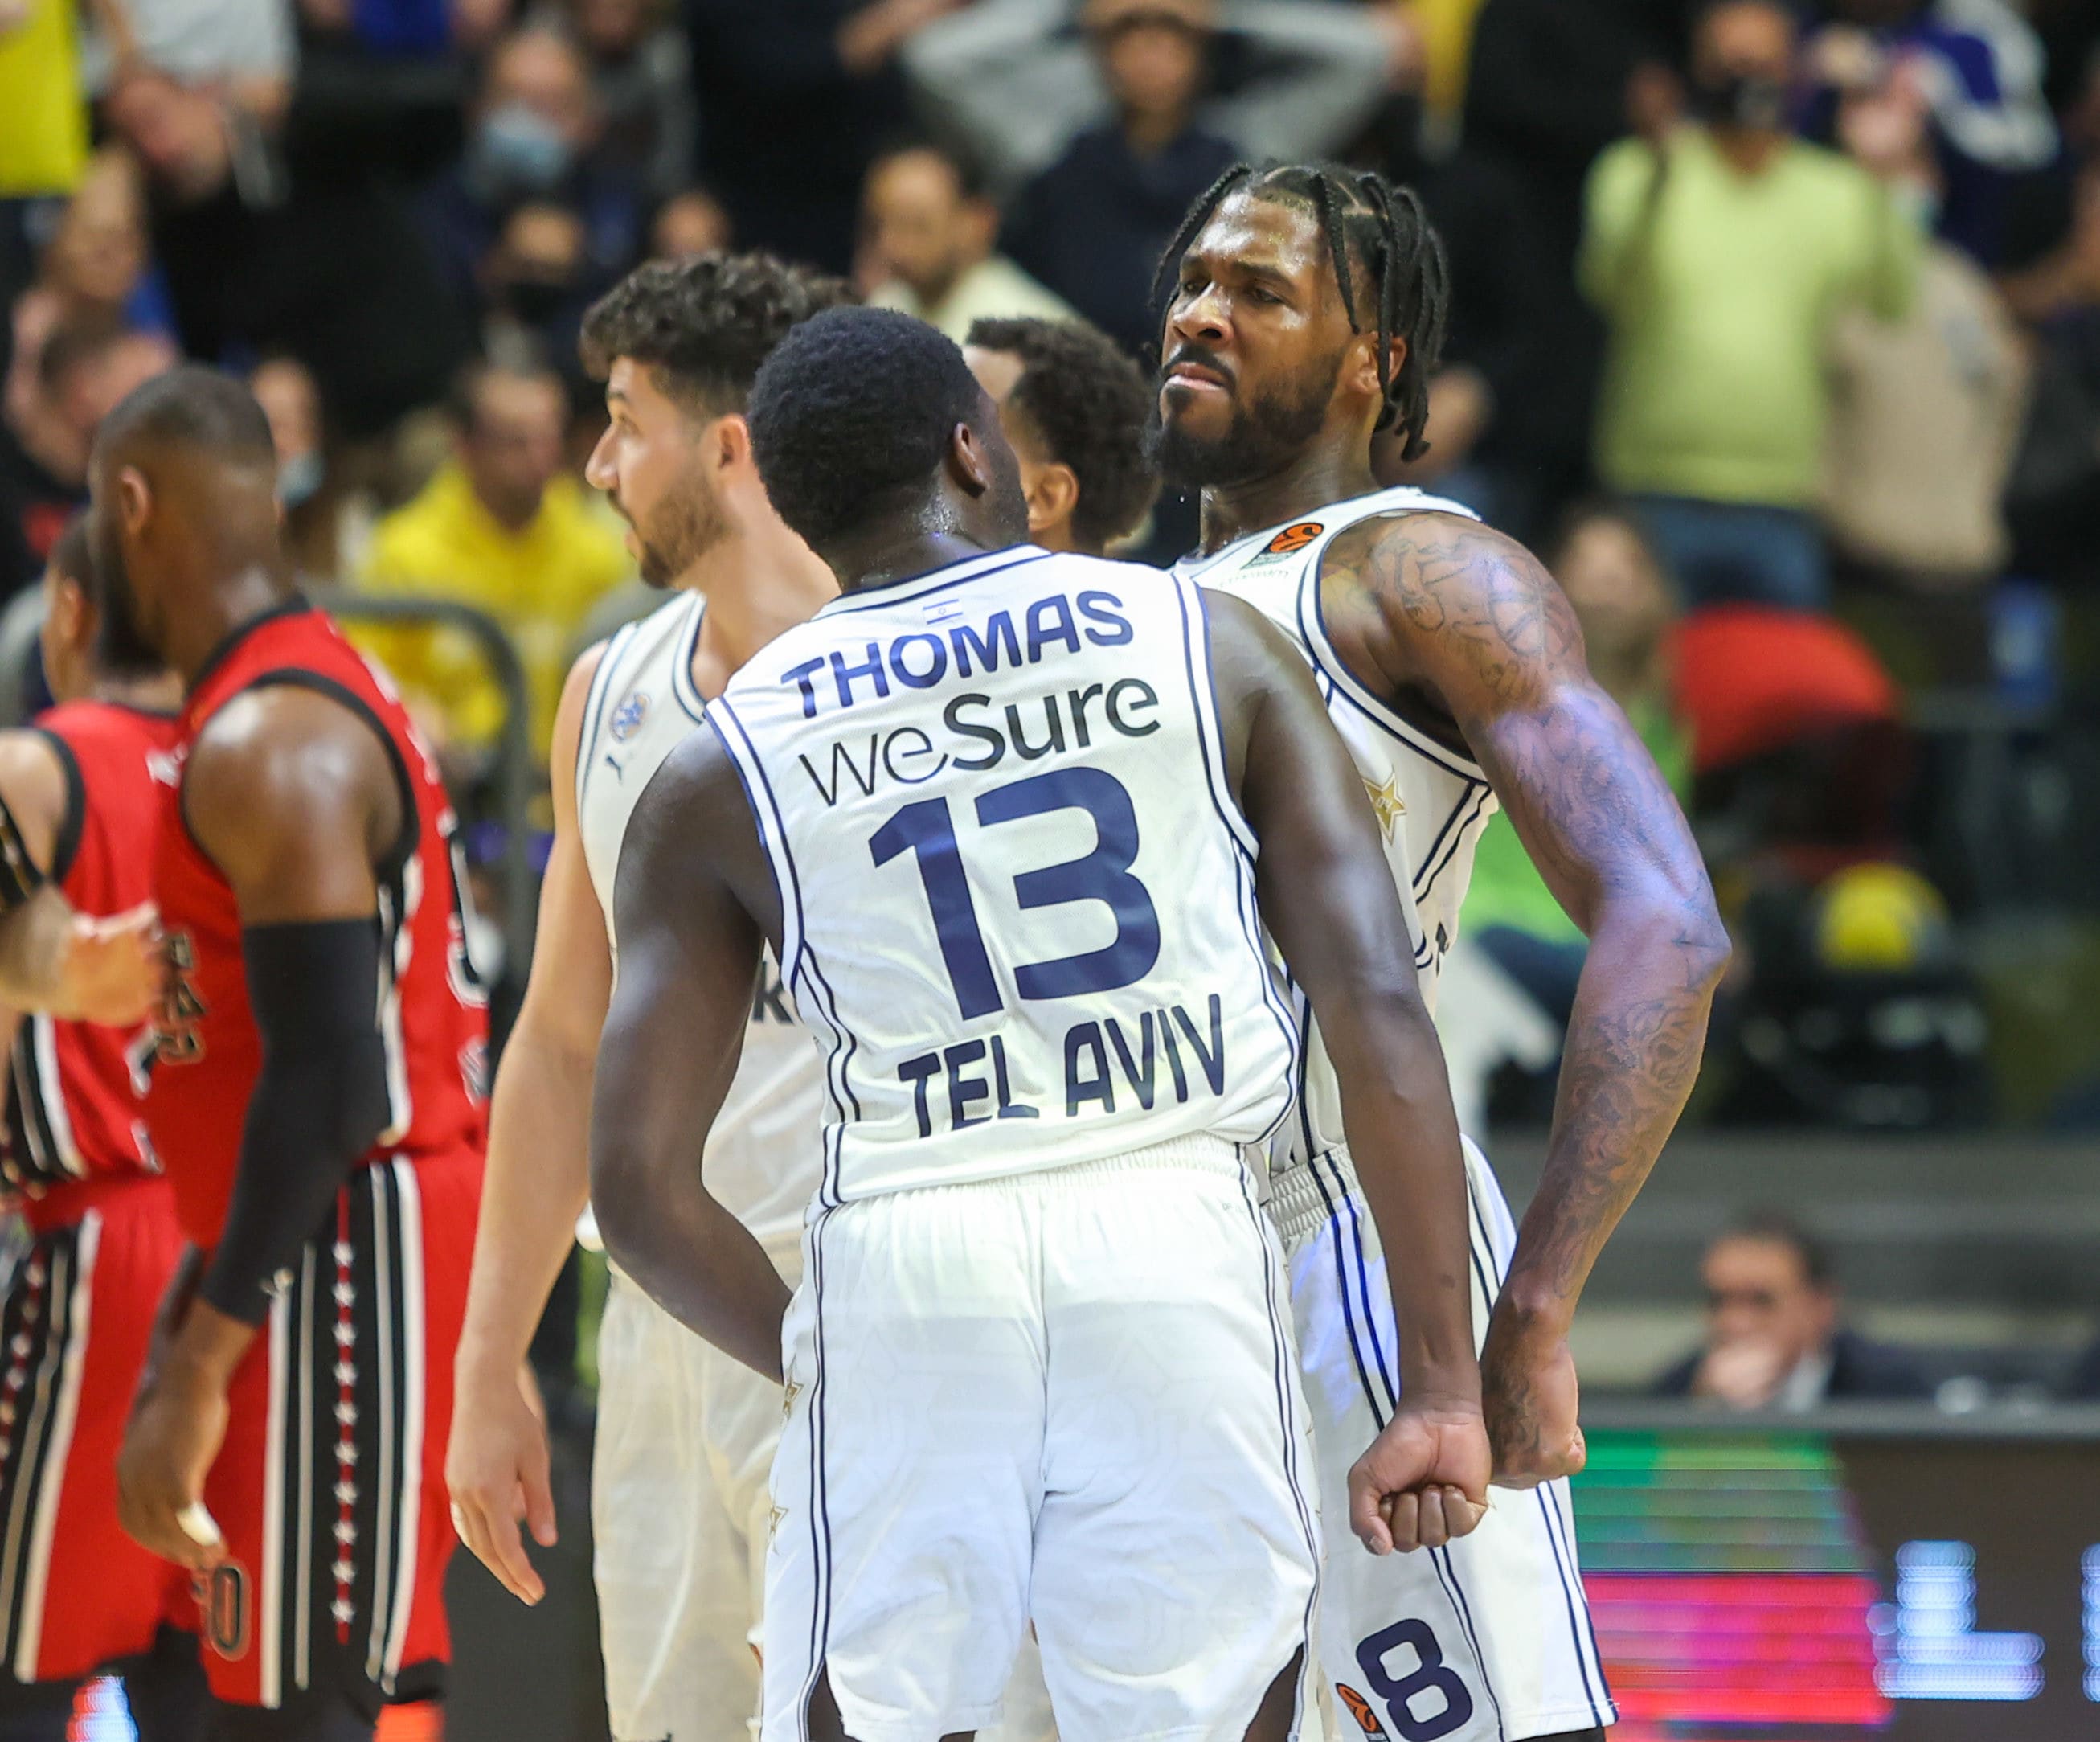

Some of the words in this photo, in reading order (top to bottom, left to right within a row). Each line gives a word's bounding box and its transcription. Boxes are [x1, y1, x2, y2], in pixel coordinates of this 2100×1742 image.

[780, 590, 1135, 719] THOMAS
[797, 678, 1161, 806] weSure
[867, 766, 1161, 1021] 13
[897, 1035, 1040, 1138] TEL
[1065, 994, 1225, 1117] AVIV
[1355, 1617, 1474, 1742] 8
